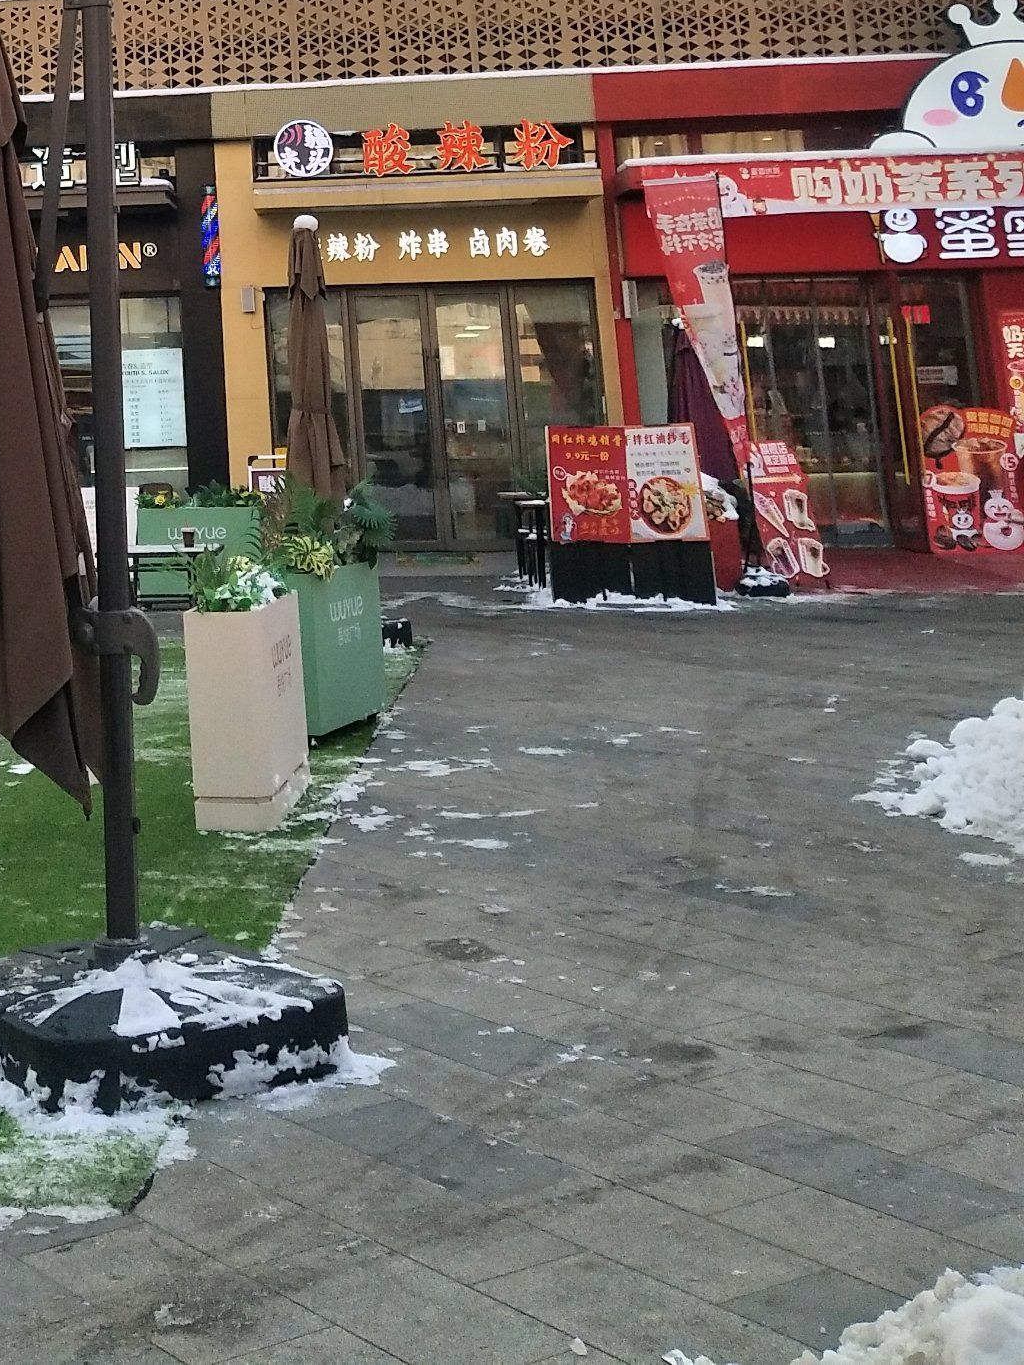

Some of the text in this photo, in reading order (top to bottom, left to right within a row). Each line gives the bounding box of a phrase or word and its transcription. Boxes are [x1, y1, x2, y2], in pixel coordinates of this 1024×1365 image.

[362, 118, 574, 177] 酸辣粉
[318, 226, 550, 262] 辣粉 炸串 卤肉卷
